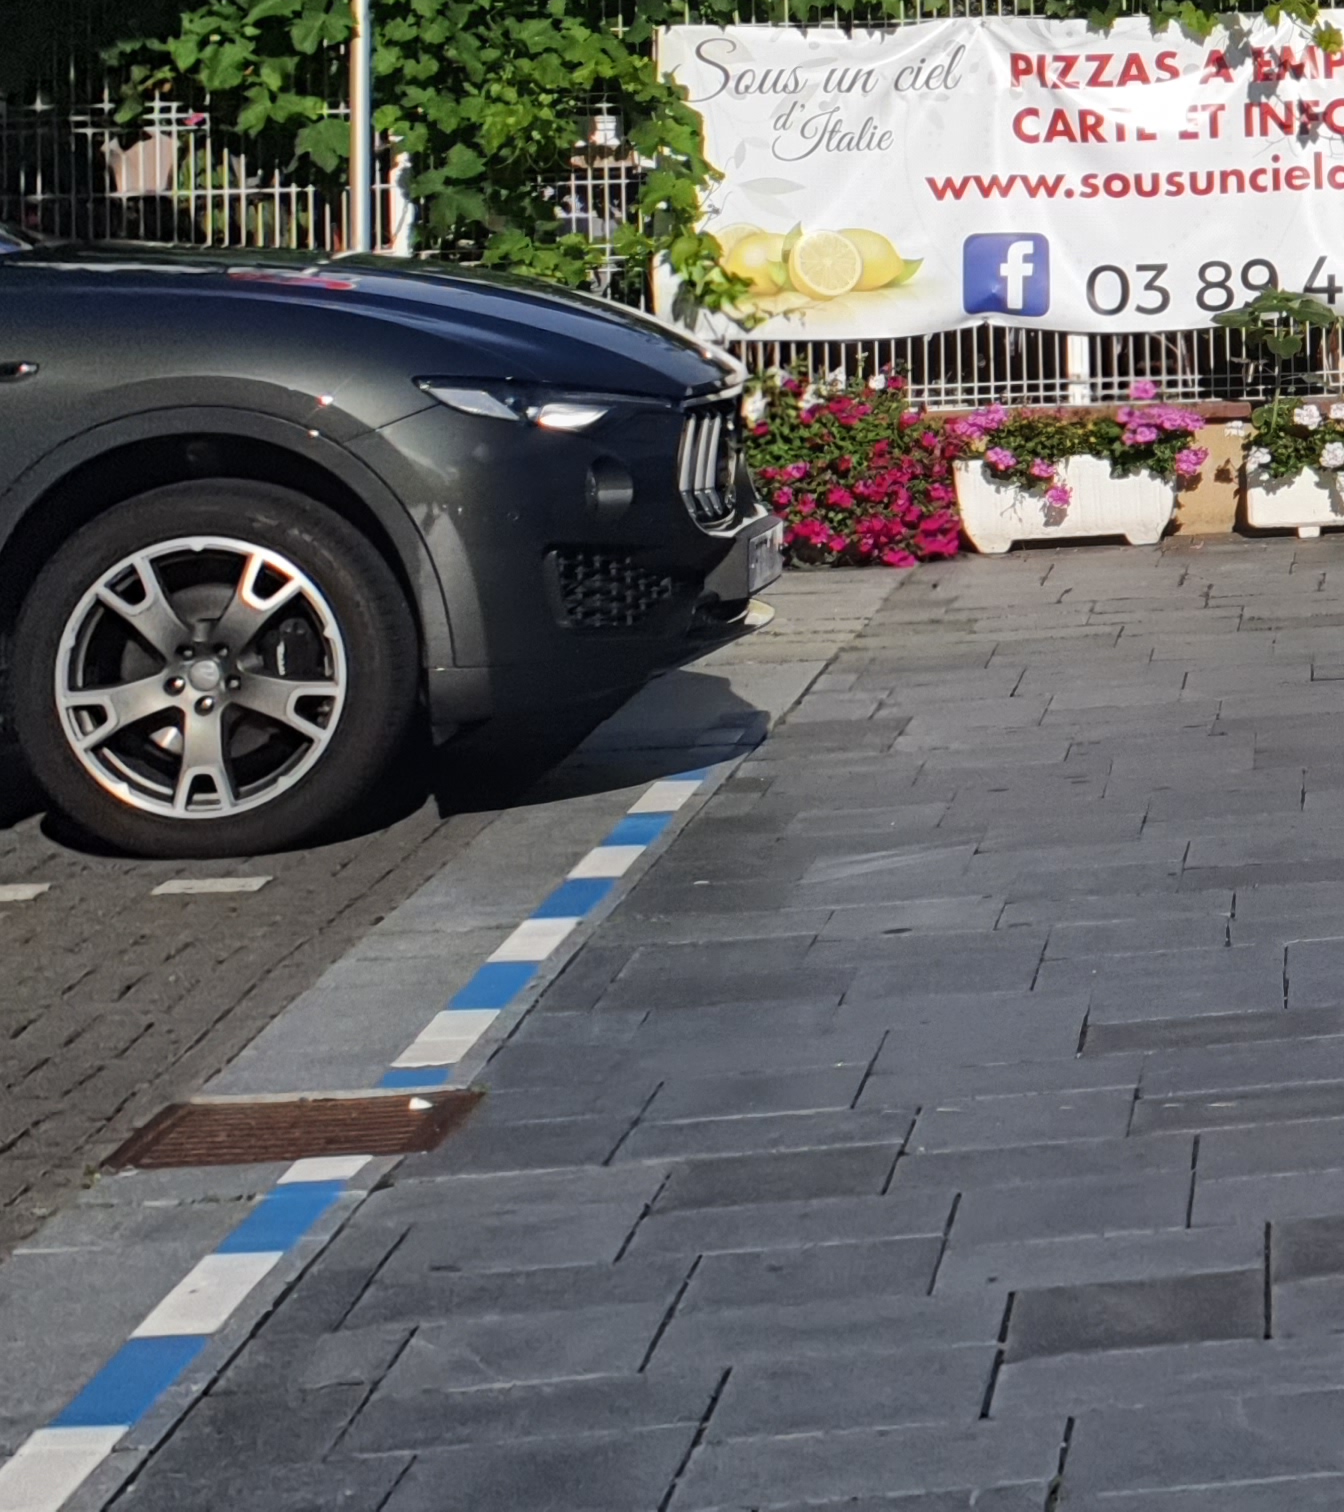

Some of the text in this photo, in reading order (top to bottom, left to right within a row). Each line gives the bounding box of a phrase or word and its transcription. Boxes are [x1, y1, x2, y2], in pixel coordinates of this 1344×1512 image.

[686, 37, 966, 102] Sous un ciel
[1009, 50, 1181, 89] PIZZAS
[771, 100, 895, 162] d'Italie
[1178, 102, 1227, 141] ET
[1086, 263, 1171, 317] 03
[1195, 257, 1279, 313] 89
